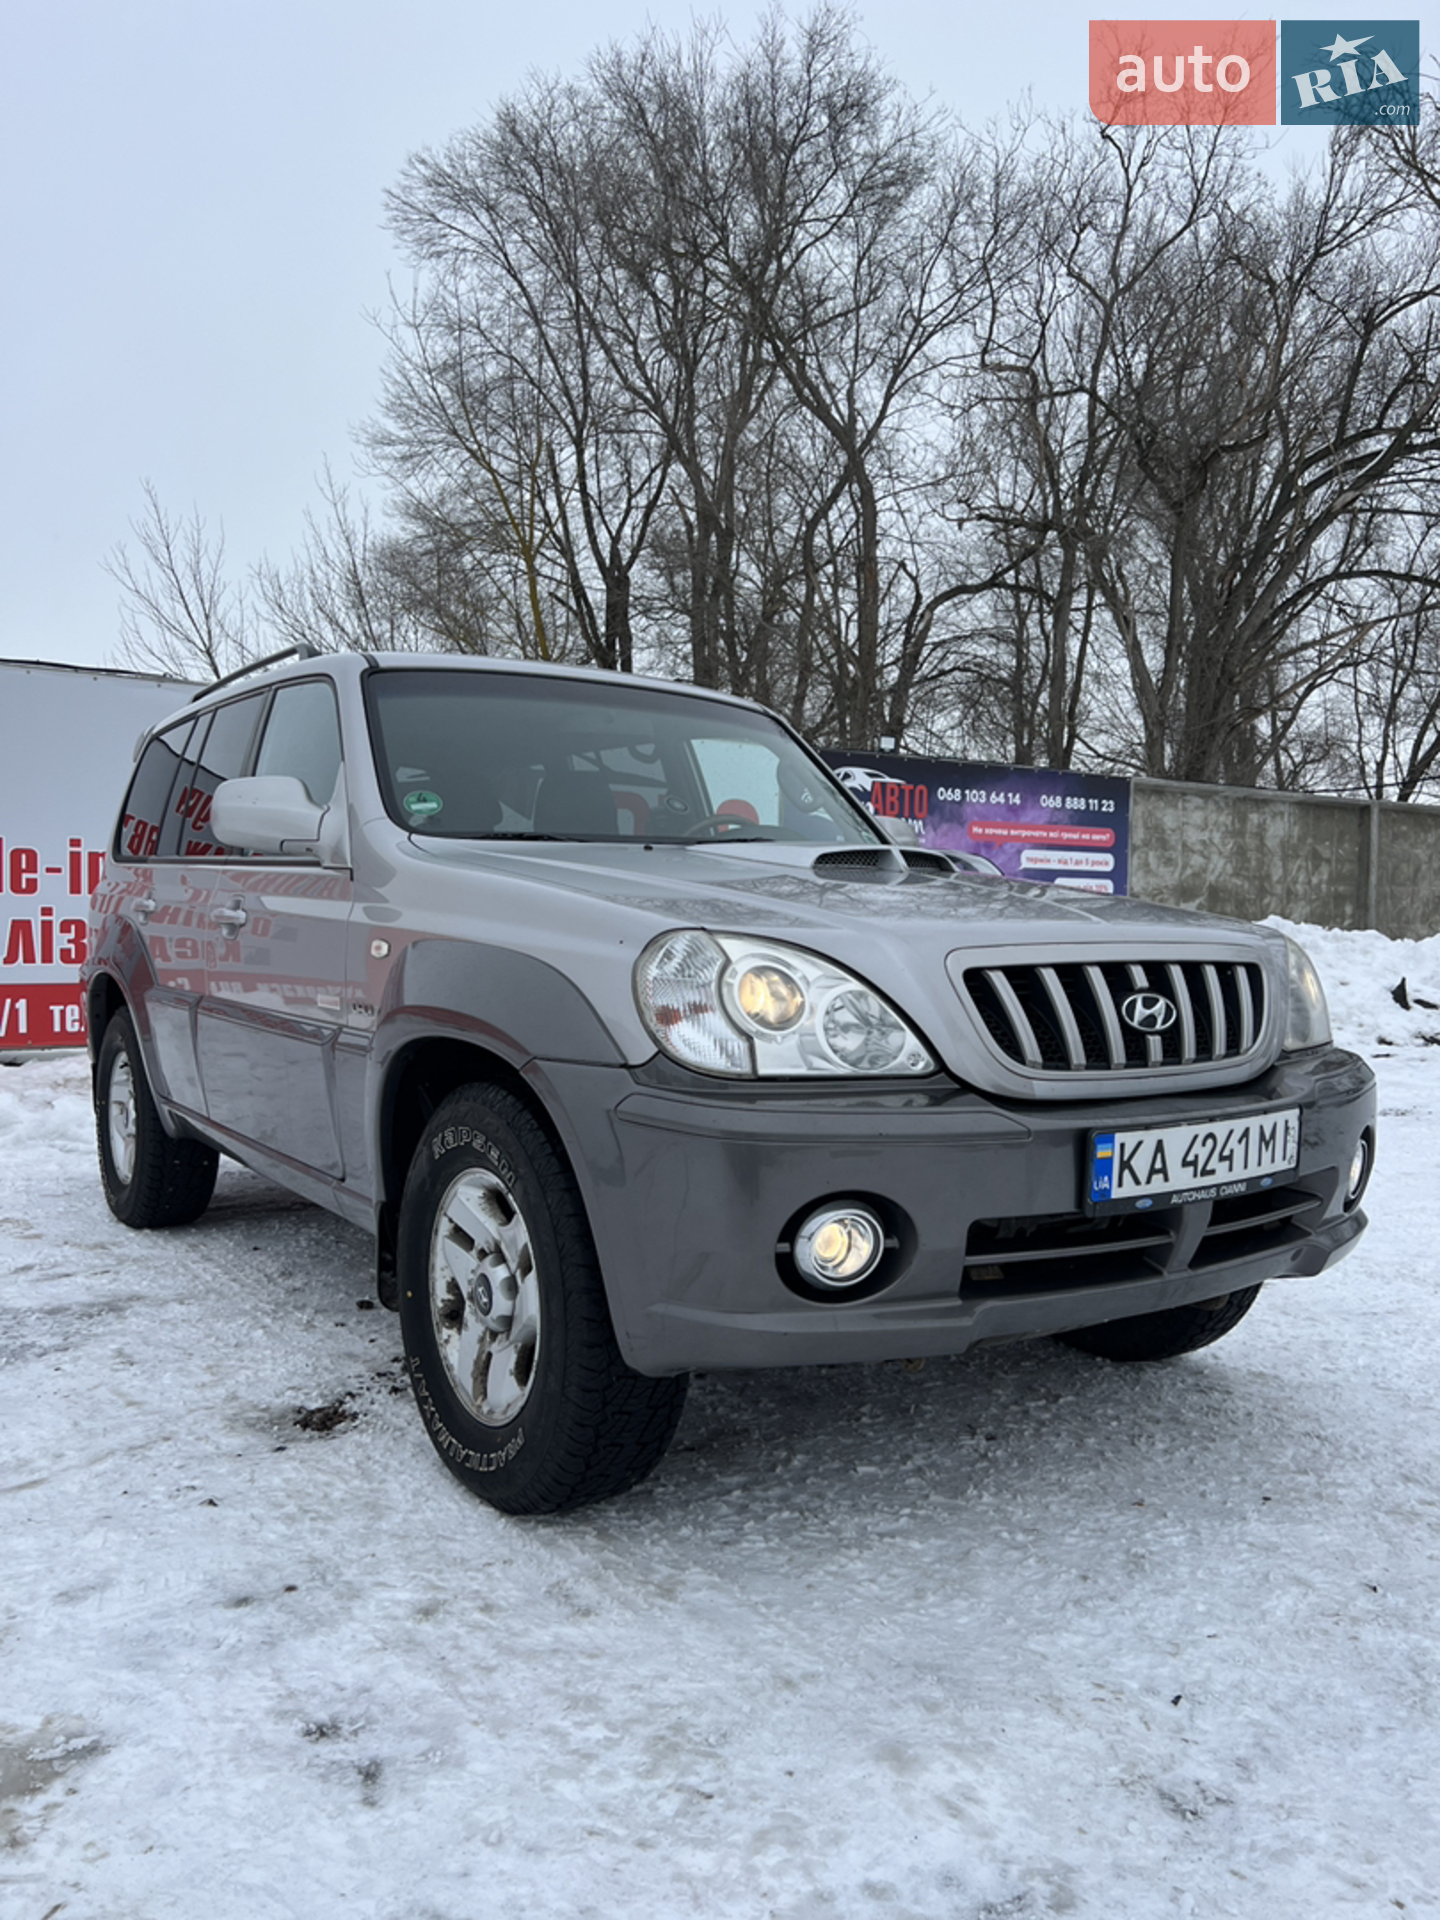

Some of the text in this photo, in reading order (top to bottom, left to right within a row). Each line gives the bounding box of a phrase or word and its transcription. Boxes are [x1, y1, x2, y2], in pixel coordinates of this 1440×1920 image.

[871, 782, 928, 818] АВТО
[937, 786, 1021, 806] 068 103 64 14
[1039, 795, 1115, 813] 068 888 11 23
[49, 1004, 86, 1032] те
